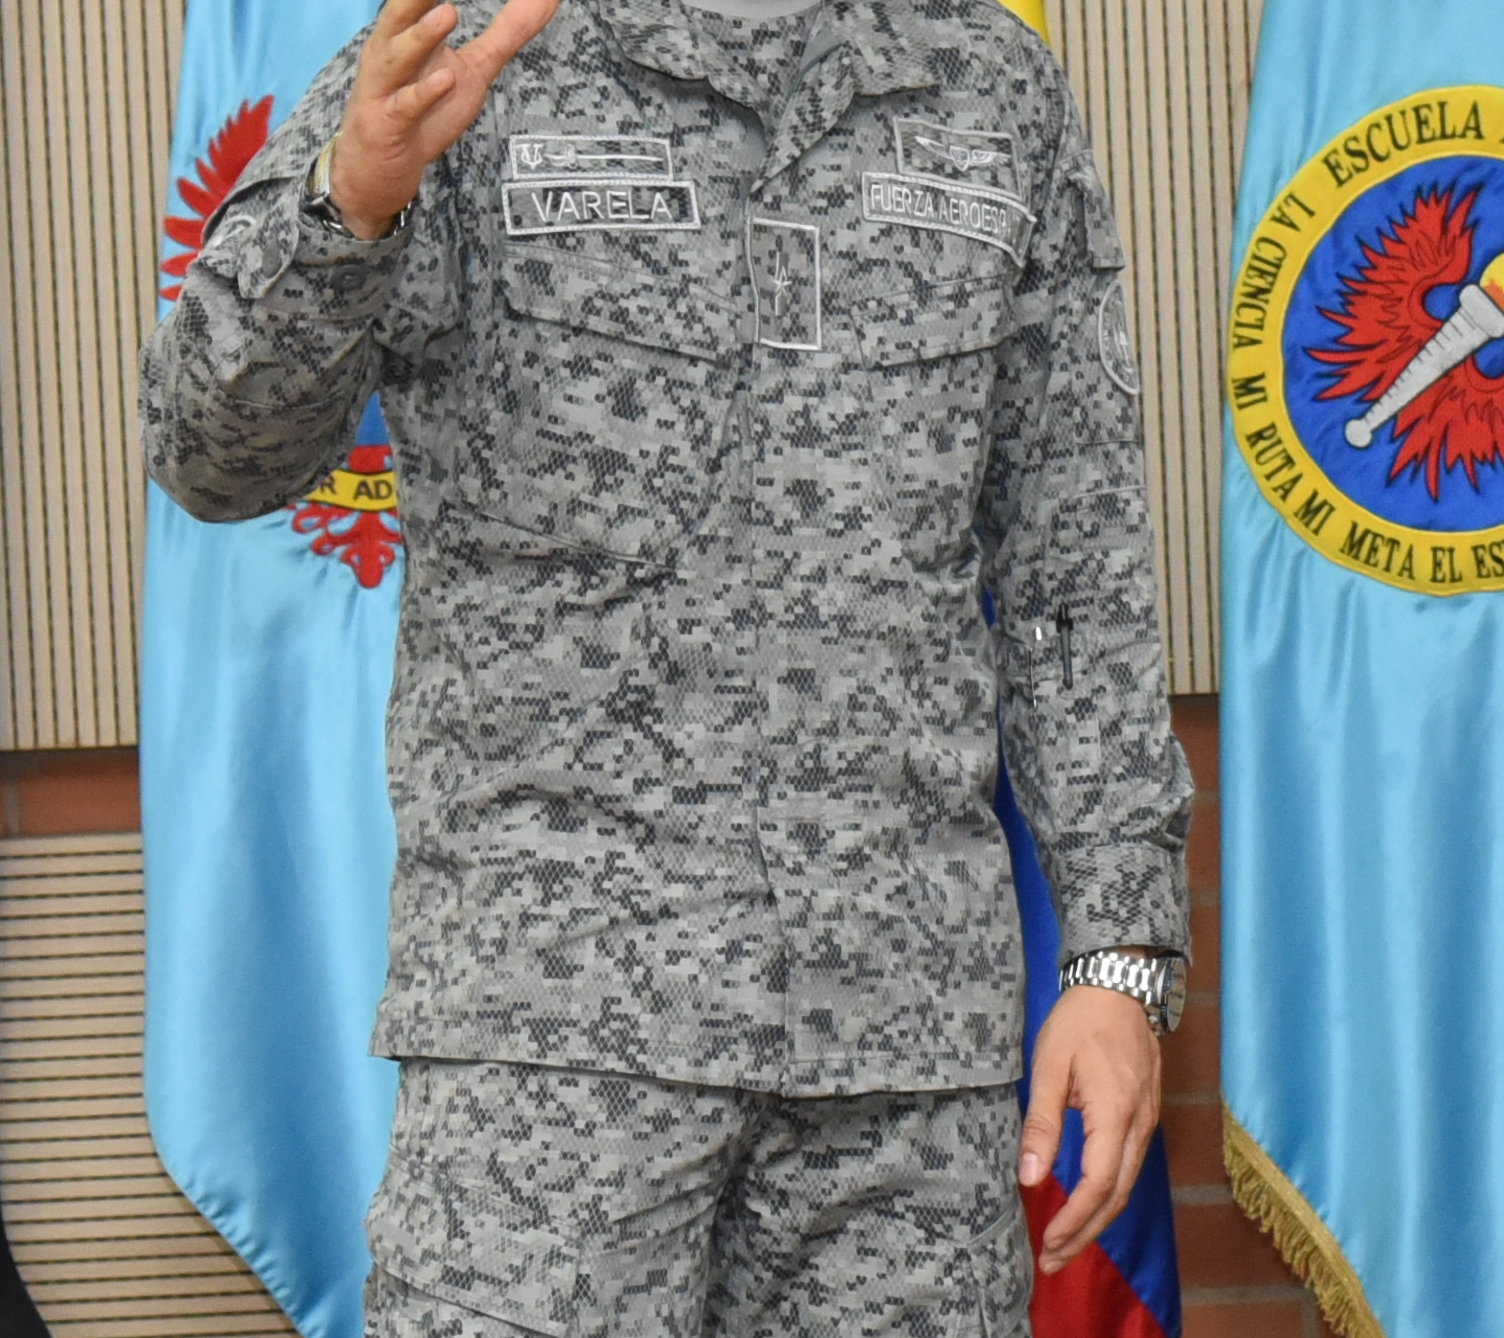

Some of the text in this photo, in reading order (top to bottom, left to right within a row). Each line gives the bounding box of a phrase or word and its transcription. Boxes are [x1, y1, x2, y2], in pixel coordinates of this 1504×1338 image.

[1321, 99, 1486, 188] ESCUELA
[531, 189, 674, 222] VARELA
[870, 184, 935, 218] FUERZA
[1268, 191, 1317, 232] LA
[1232, 236, 1288, 351] CIENCIA
[1232, 371, 1268, 411] MI
[1245, 421, 1303, 503] RUTA
[1293, 488, 1336, 547] MI
[1339, 520, 1416, 580] META
[1429, 546, 1463, 583] EL
